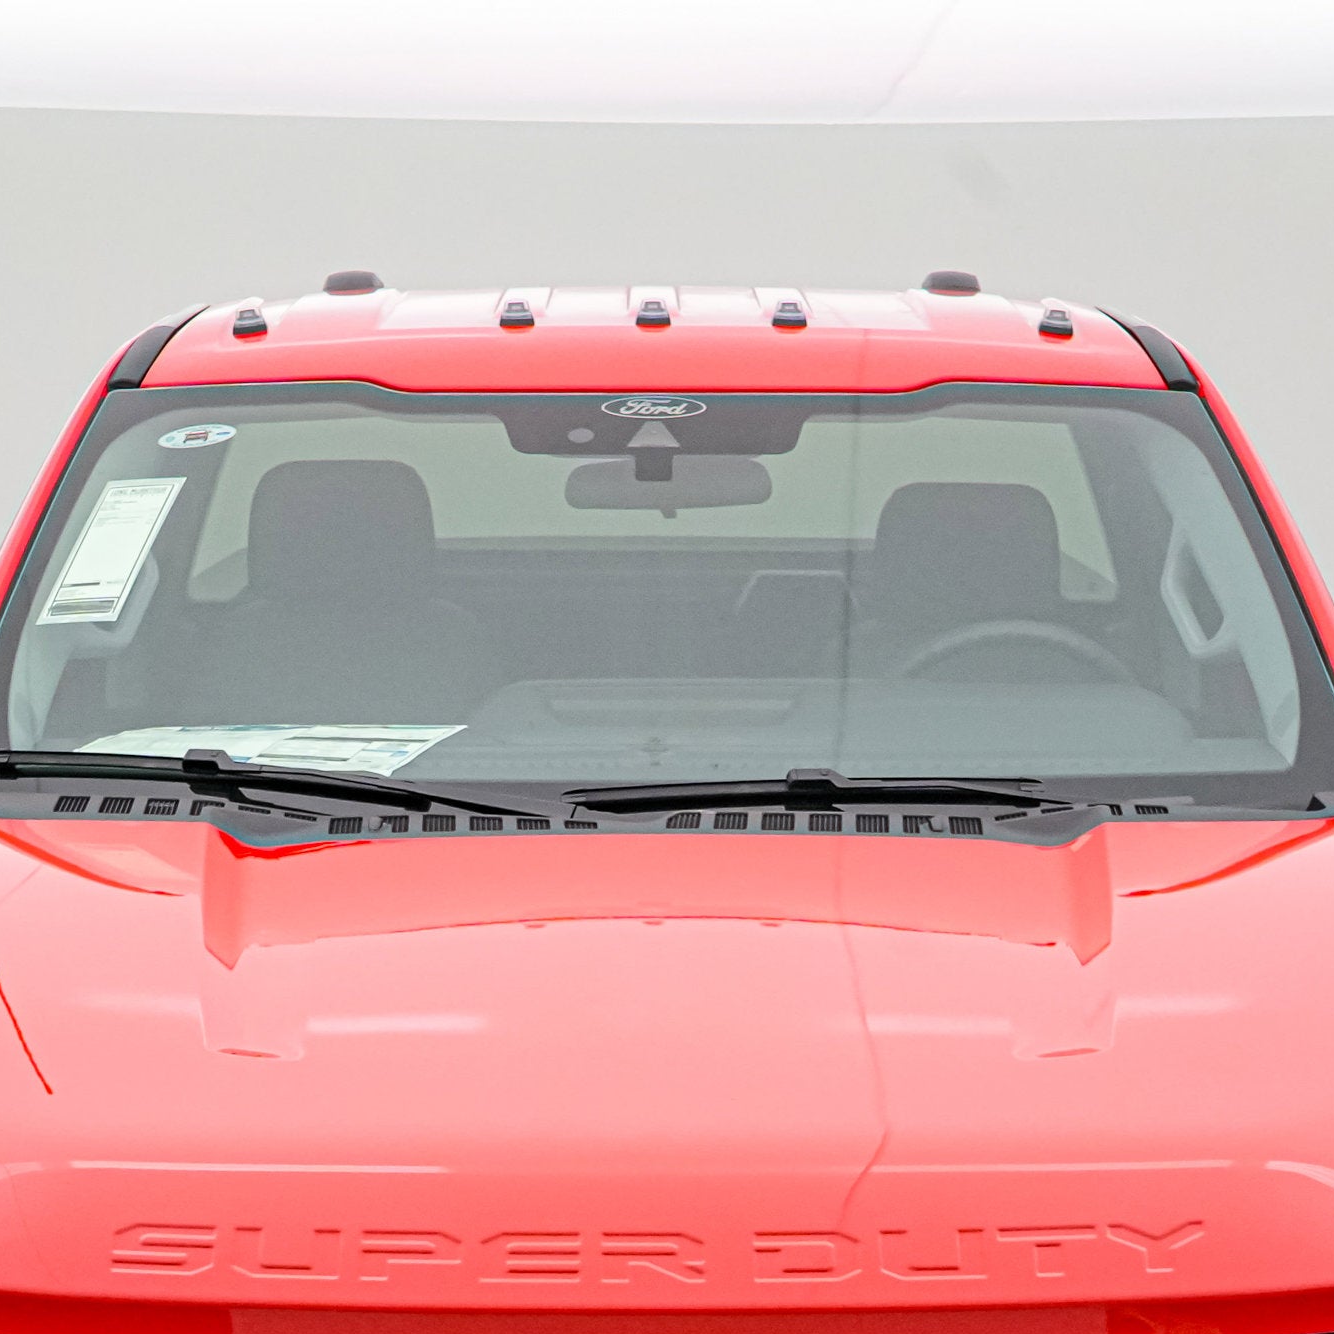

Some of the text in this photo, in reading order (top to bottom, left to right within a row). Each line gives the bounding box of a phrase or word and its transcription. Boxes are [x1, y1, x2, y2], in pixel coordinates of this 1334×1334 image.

[619, 399, 688, 415] Ford
[111, 1220, 1205, 1284] SUPER DUTY
